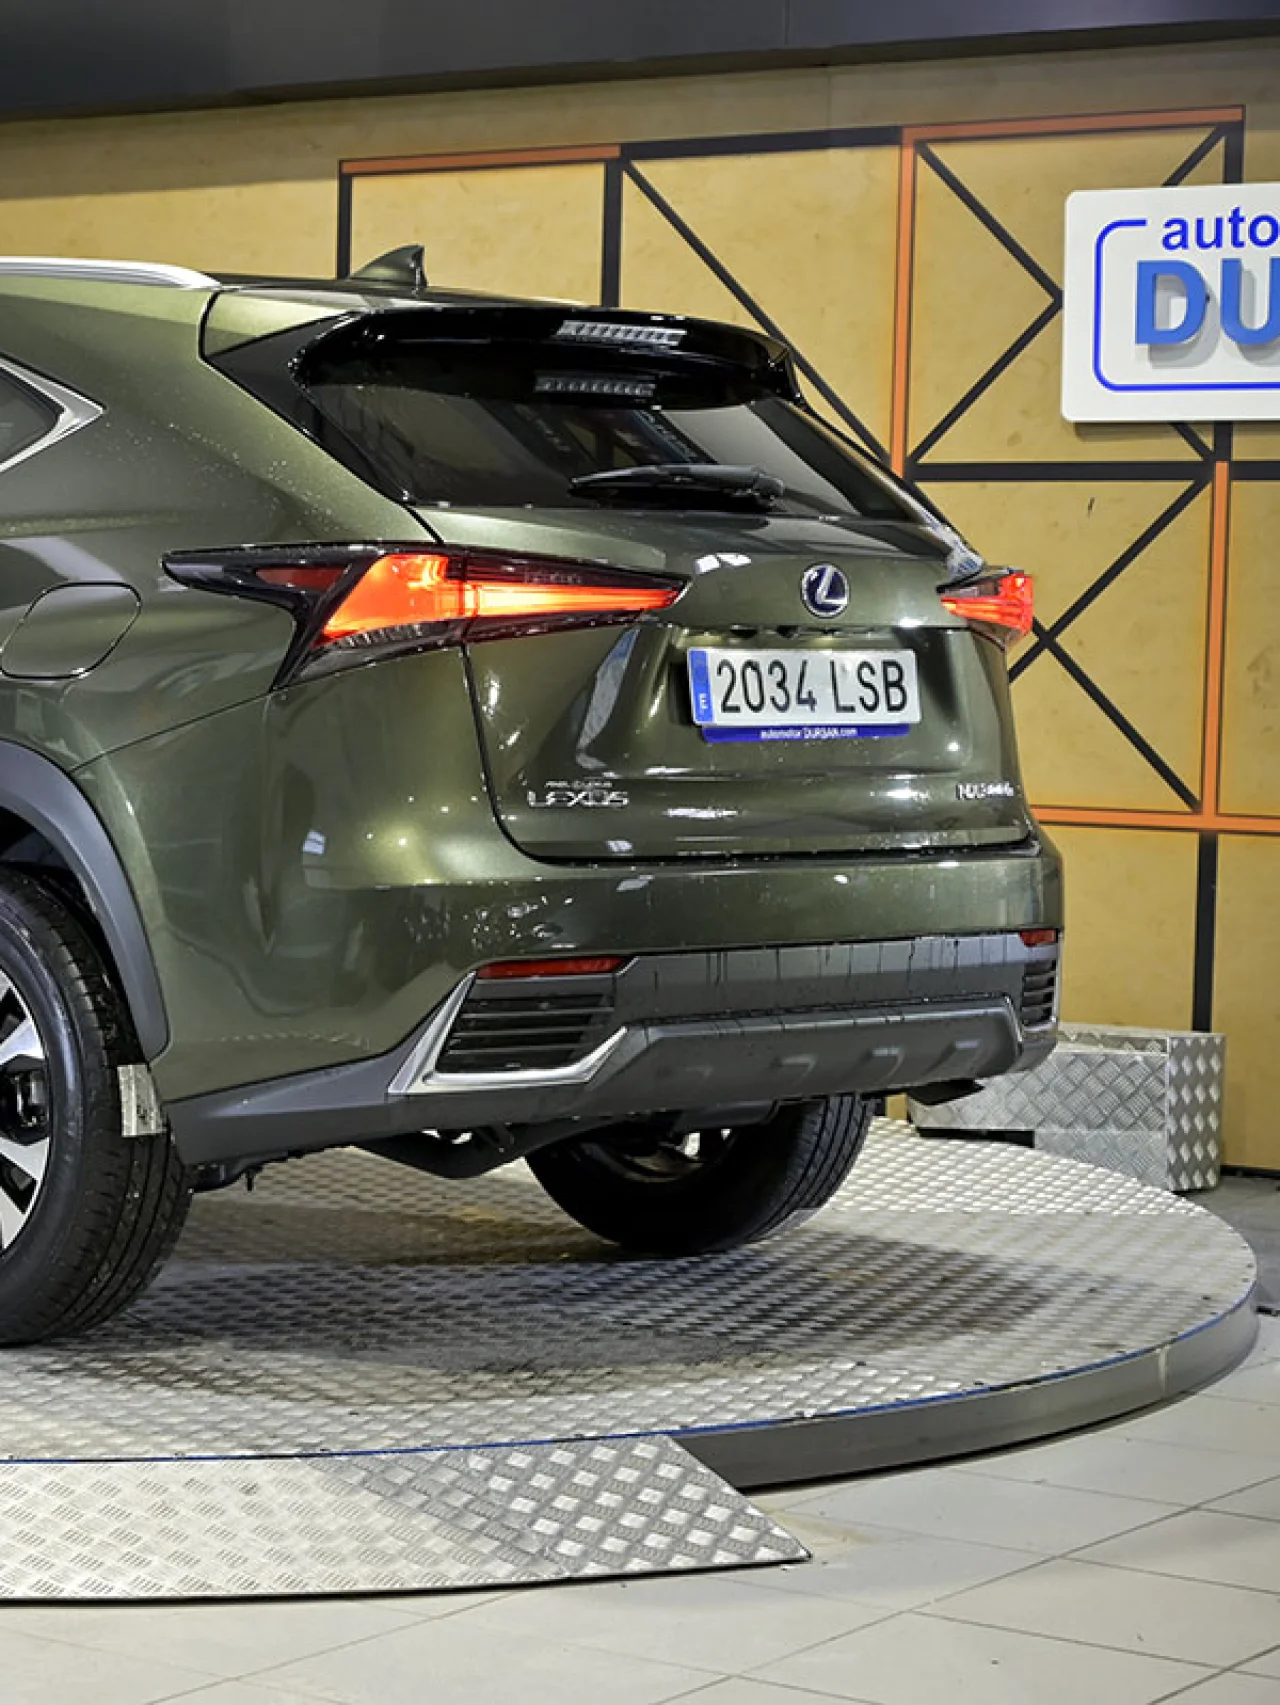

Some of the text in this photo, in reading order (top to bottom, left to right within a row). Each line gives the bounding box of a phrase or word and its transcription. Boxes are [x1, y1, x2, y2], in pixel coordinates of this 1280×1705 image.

[1162, 206, 1280, 250] auto
[1134, 257, 1280, 345] DU
[716, 659, 908, 713] 2034 LSB
[526, 791, 630, 808] LEXUS
